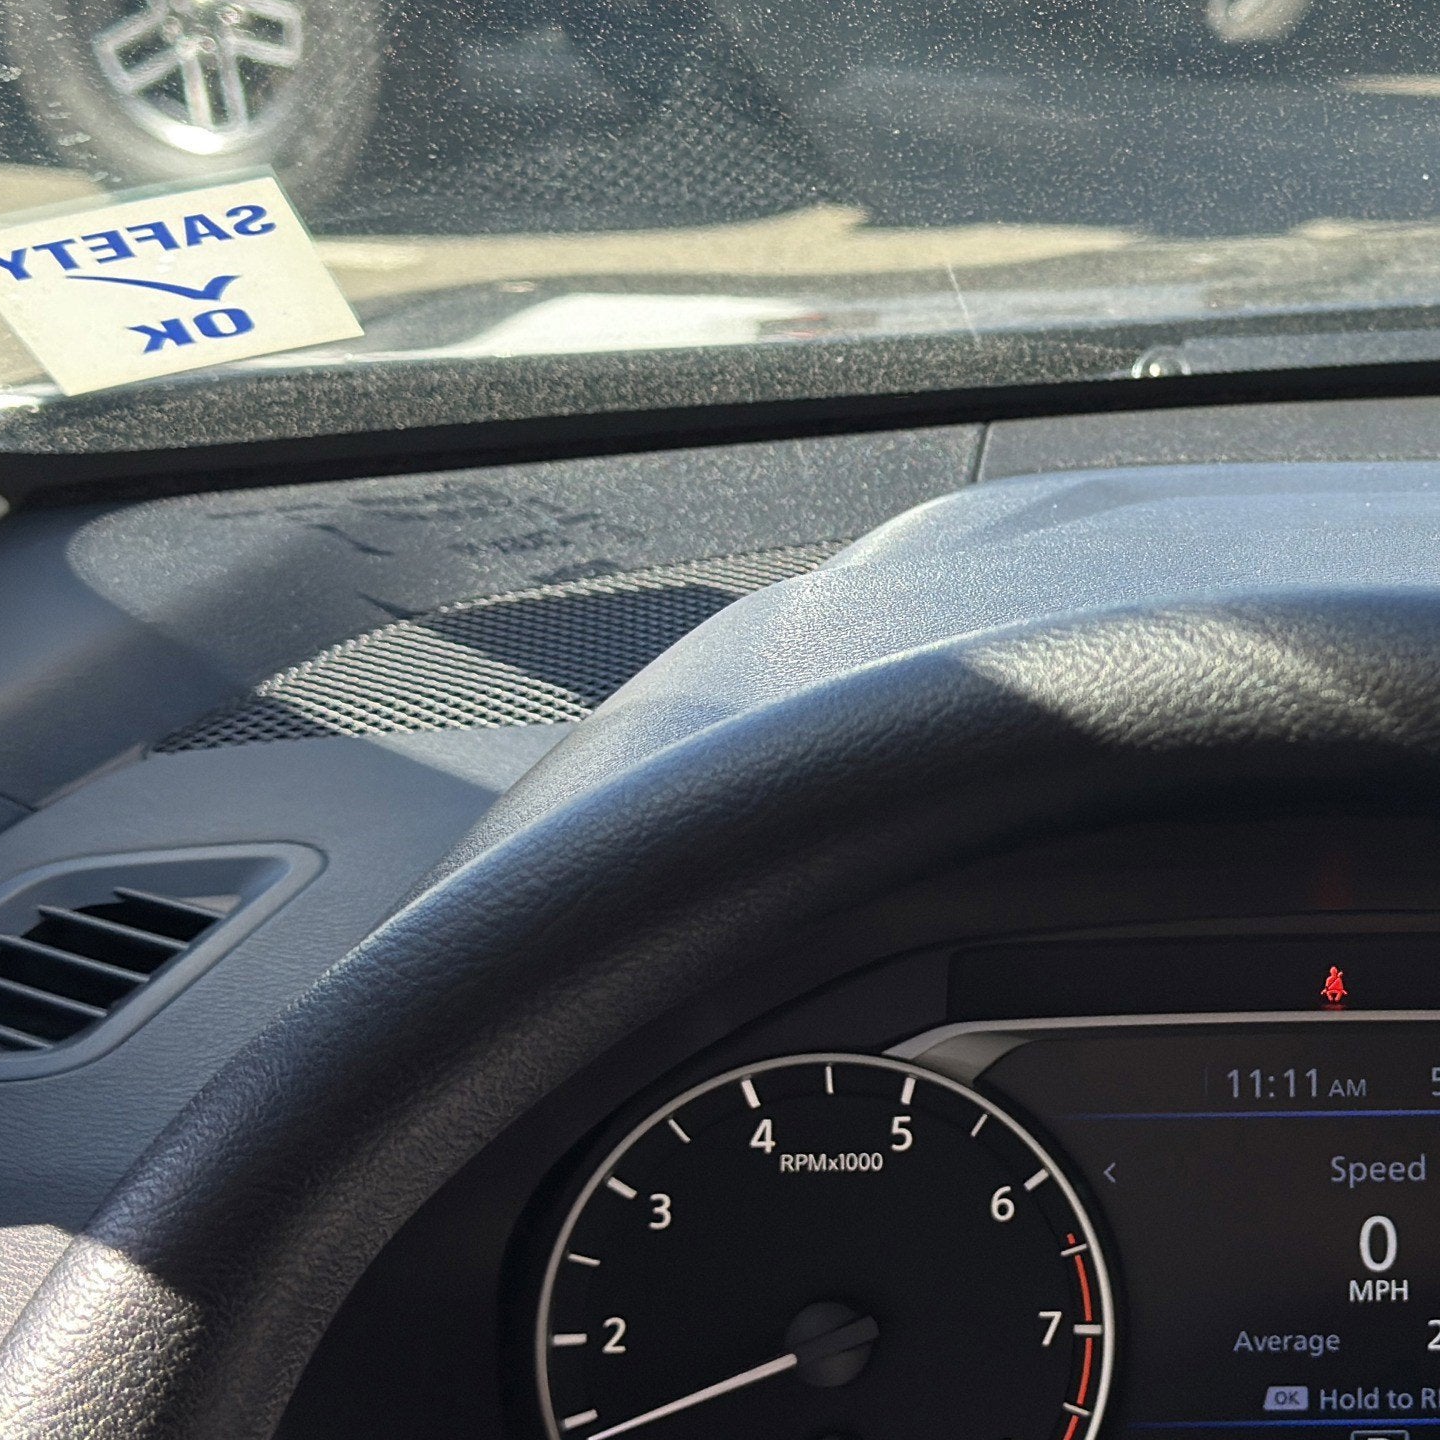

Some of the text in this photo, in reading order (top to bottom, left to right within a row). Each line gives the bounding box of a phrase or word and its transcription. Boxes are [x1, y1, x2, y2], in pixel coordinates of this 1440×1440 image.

[1227, 1068, 1367, 1099] 11:11 AM
[750, 1119, 776, 1153] 4
[891, 1116, 913, 1152] 5
[1330, 1153, 1427, 1188] Speed
[649, 1194, 672, 1230] 3
[991, 1186, 1015, 1222] 6
[1359, 1215, 1398, 1272] 0
[1349, 1280, 1409, 1302] MPH
[602, 1317, 626, 1353] 2
[1038, 1311, 1062, 1346] 7
[1233, 1330, 1340, 1357] Average
[1275, 1390, 1300, 1406] OK
[1319, 1387, 1379, 1410] Hold
[1385, 1389, 1413, 1410] to
